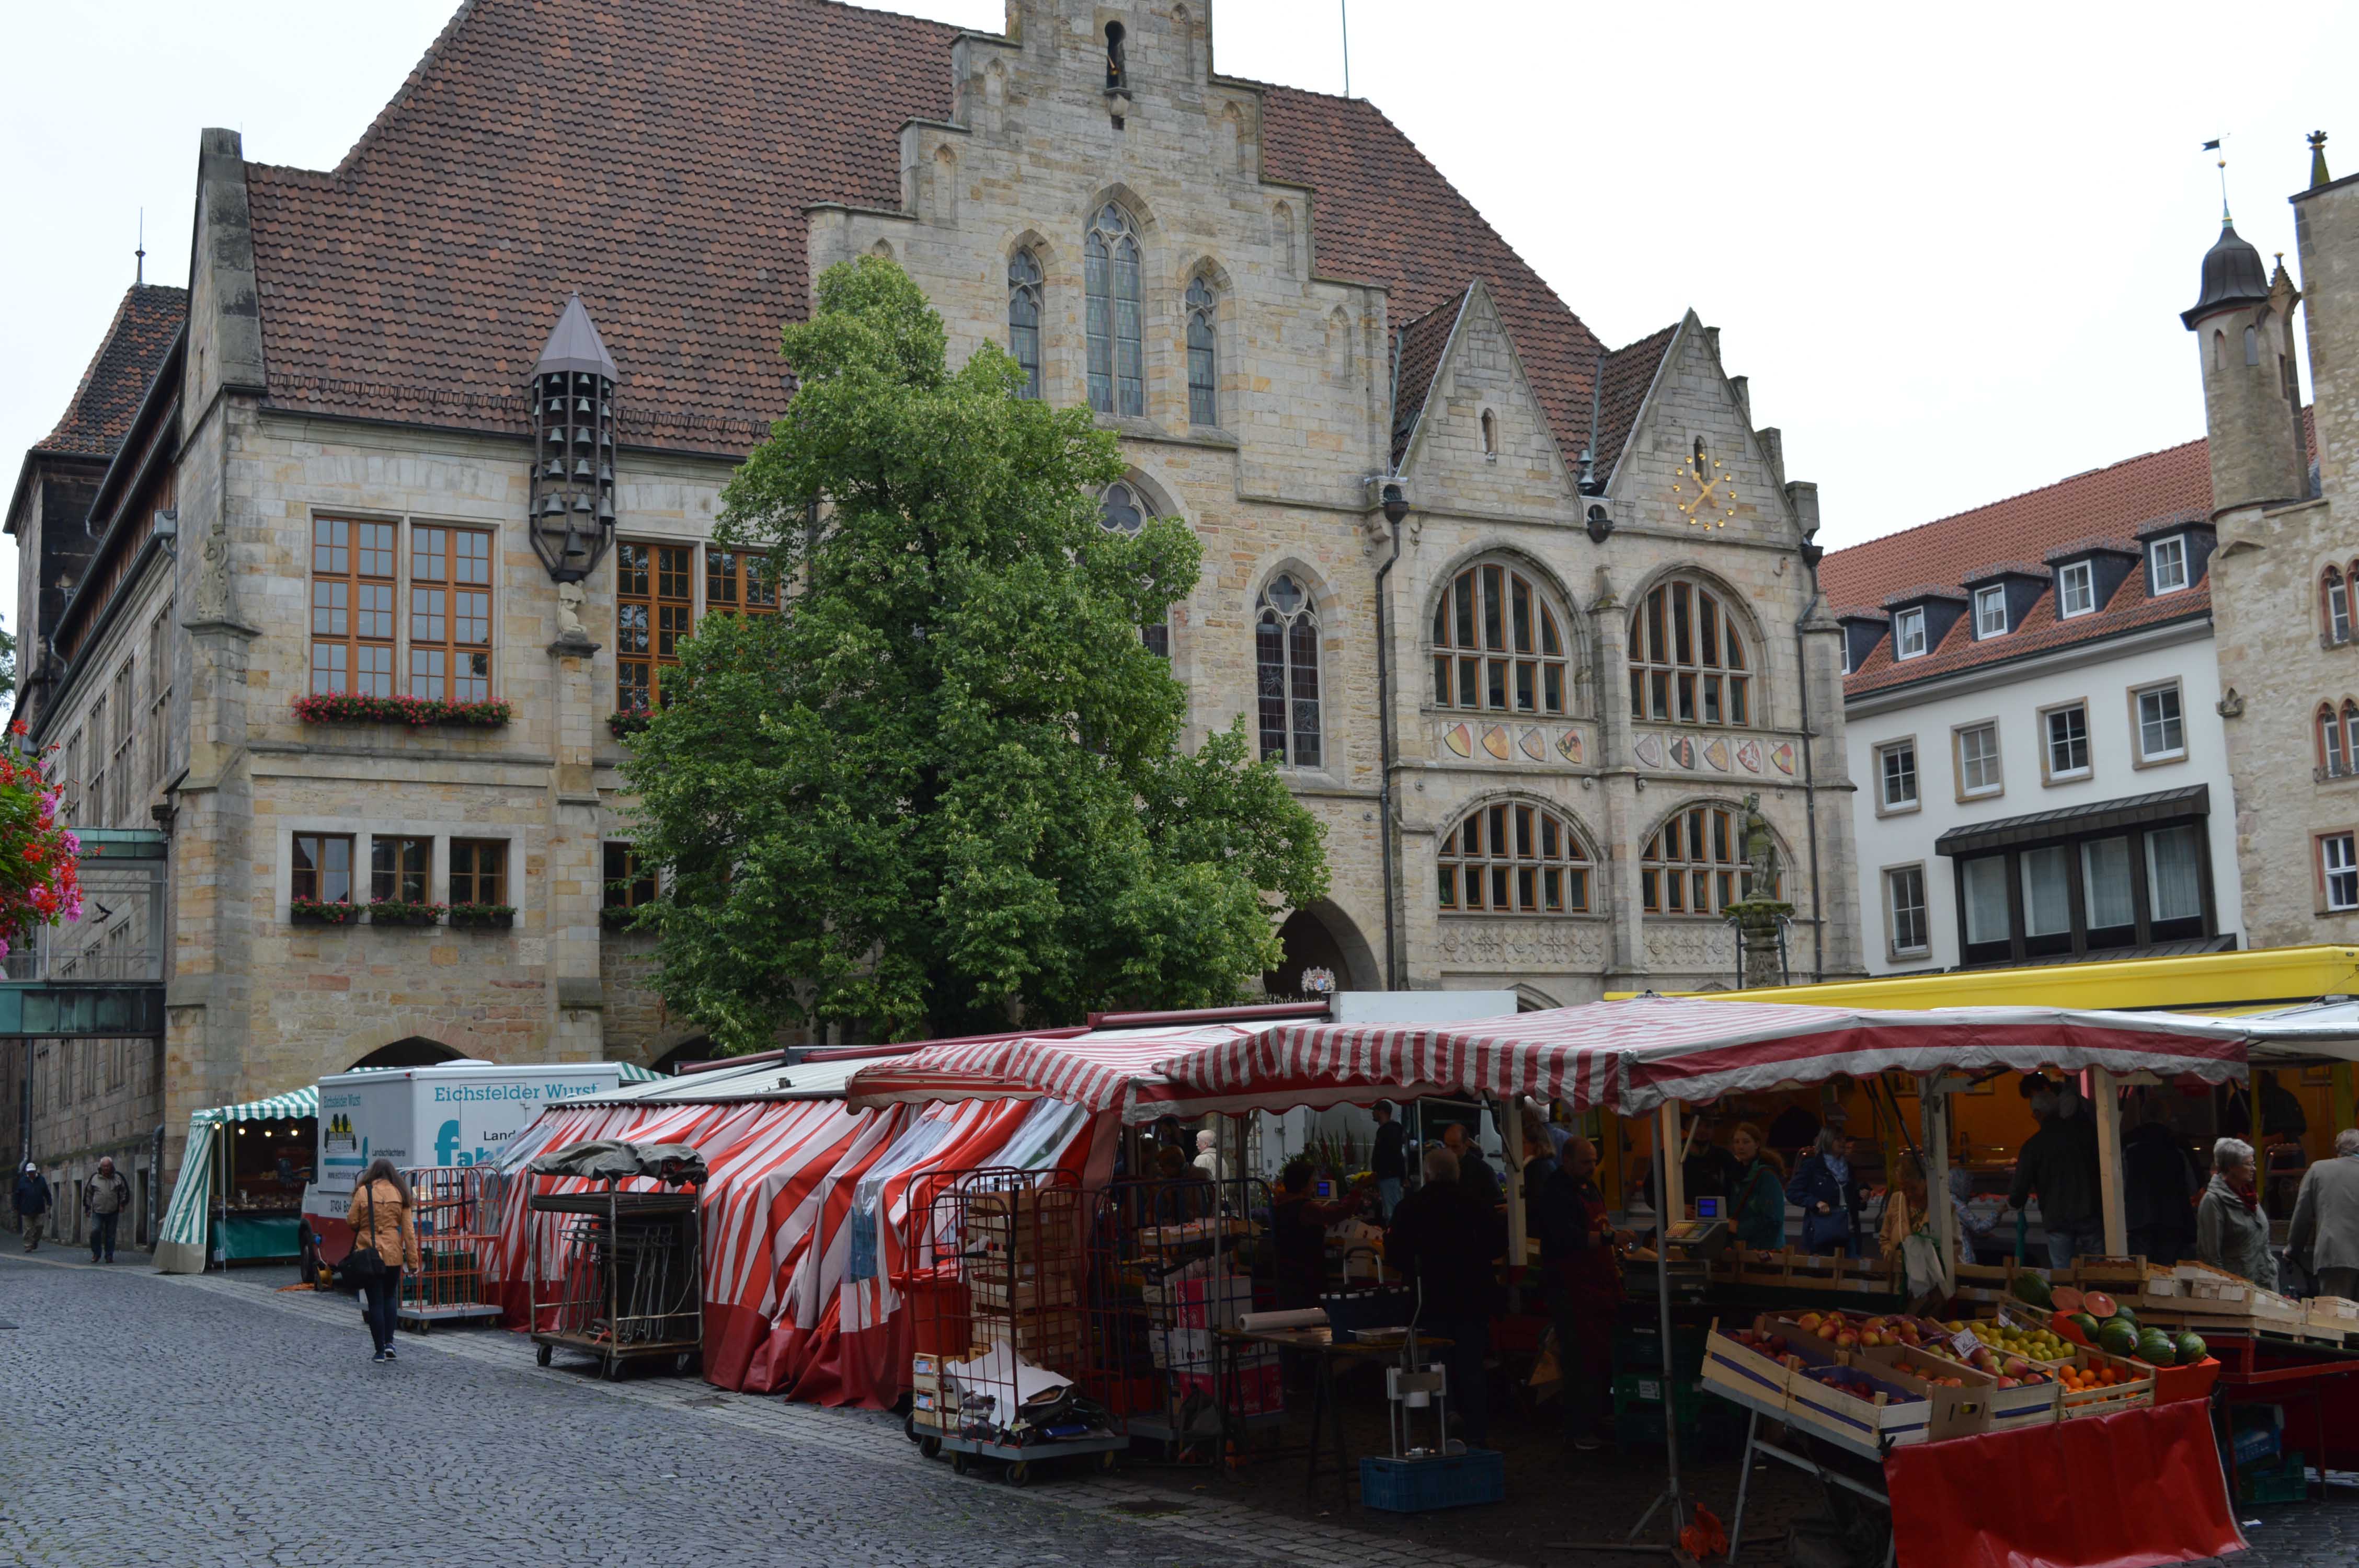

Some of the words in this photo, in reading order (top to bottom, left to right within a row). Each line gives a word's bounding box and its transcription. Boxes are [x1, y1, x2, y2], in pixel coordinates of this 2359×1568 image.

[434, 1084, 540, 1101] Eichsfelder
[545, 1083, 597, 1098] Wurst
[348, 1093, 361, 1106] Wurst
[372, 1147, 406, 1157] Landschlachterei
